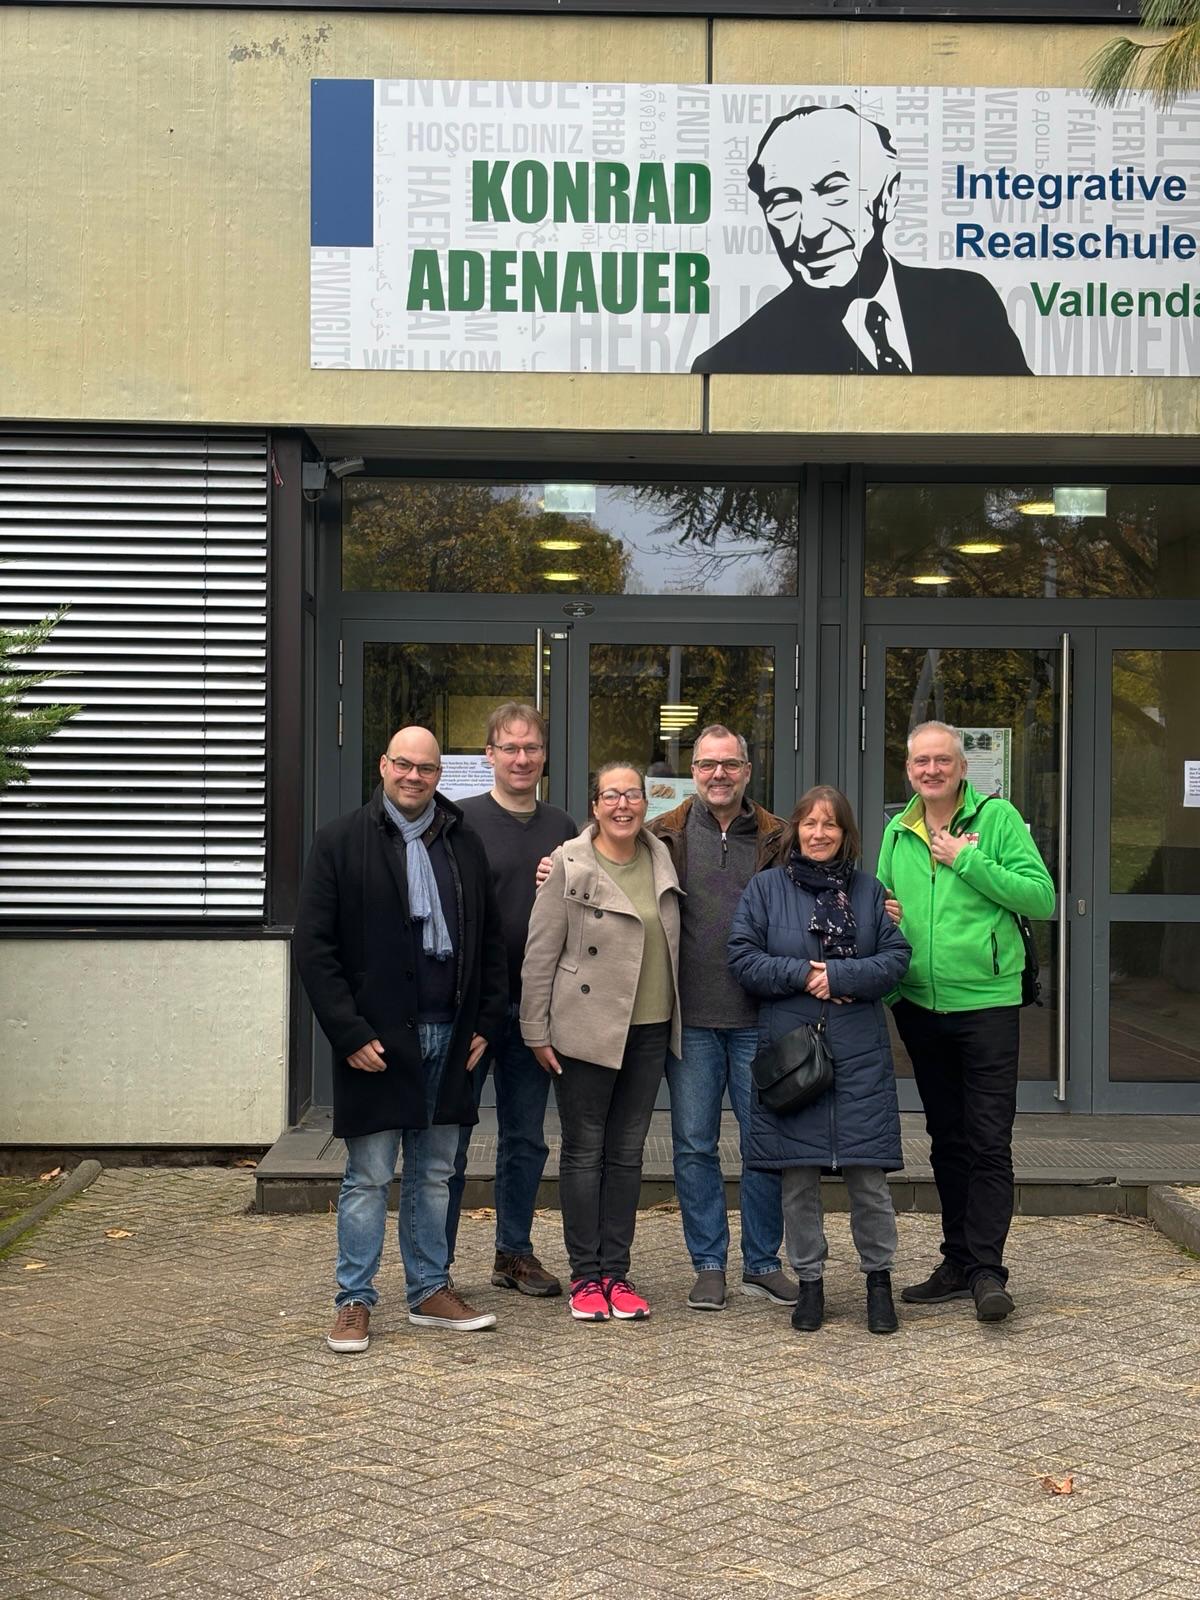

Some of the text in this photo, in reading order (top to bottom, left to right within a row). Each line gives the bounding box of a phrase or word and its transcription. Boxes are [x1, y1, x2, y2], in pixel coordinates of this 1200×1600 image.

[677, 85, 710, 166] VENUT
[407, 166, 451, 271] HAER
[472, 159, 711, 225] KONRAD
[956, 164, 1187, 210] Integrative
[956, 223, 1197, 259] Realschule
[406, 249, 711, 315] ADENAUER
